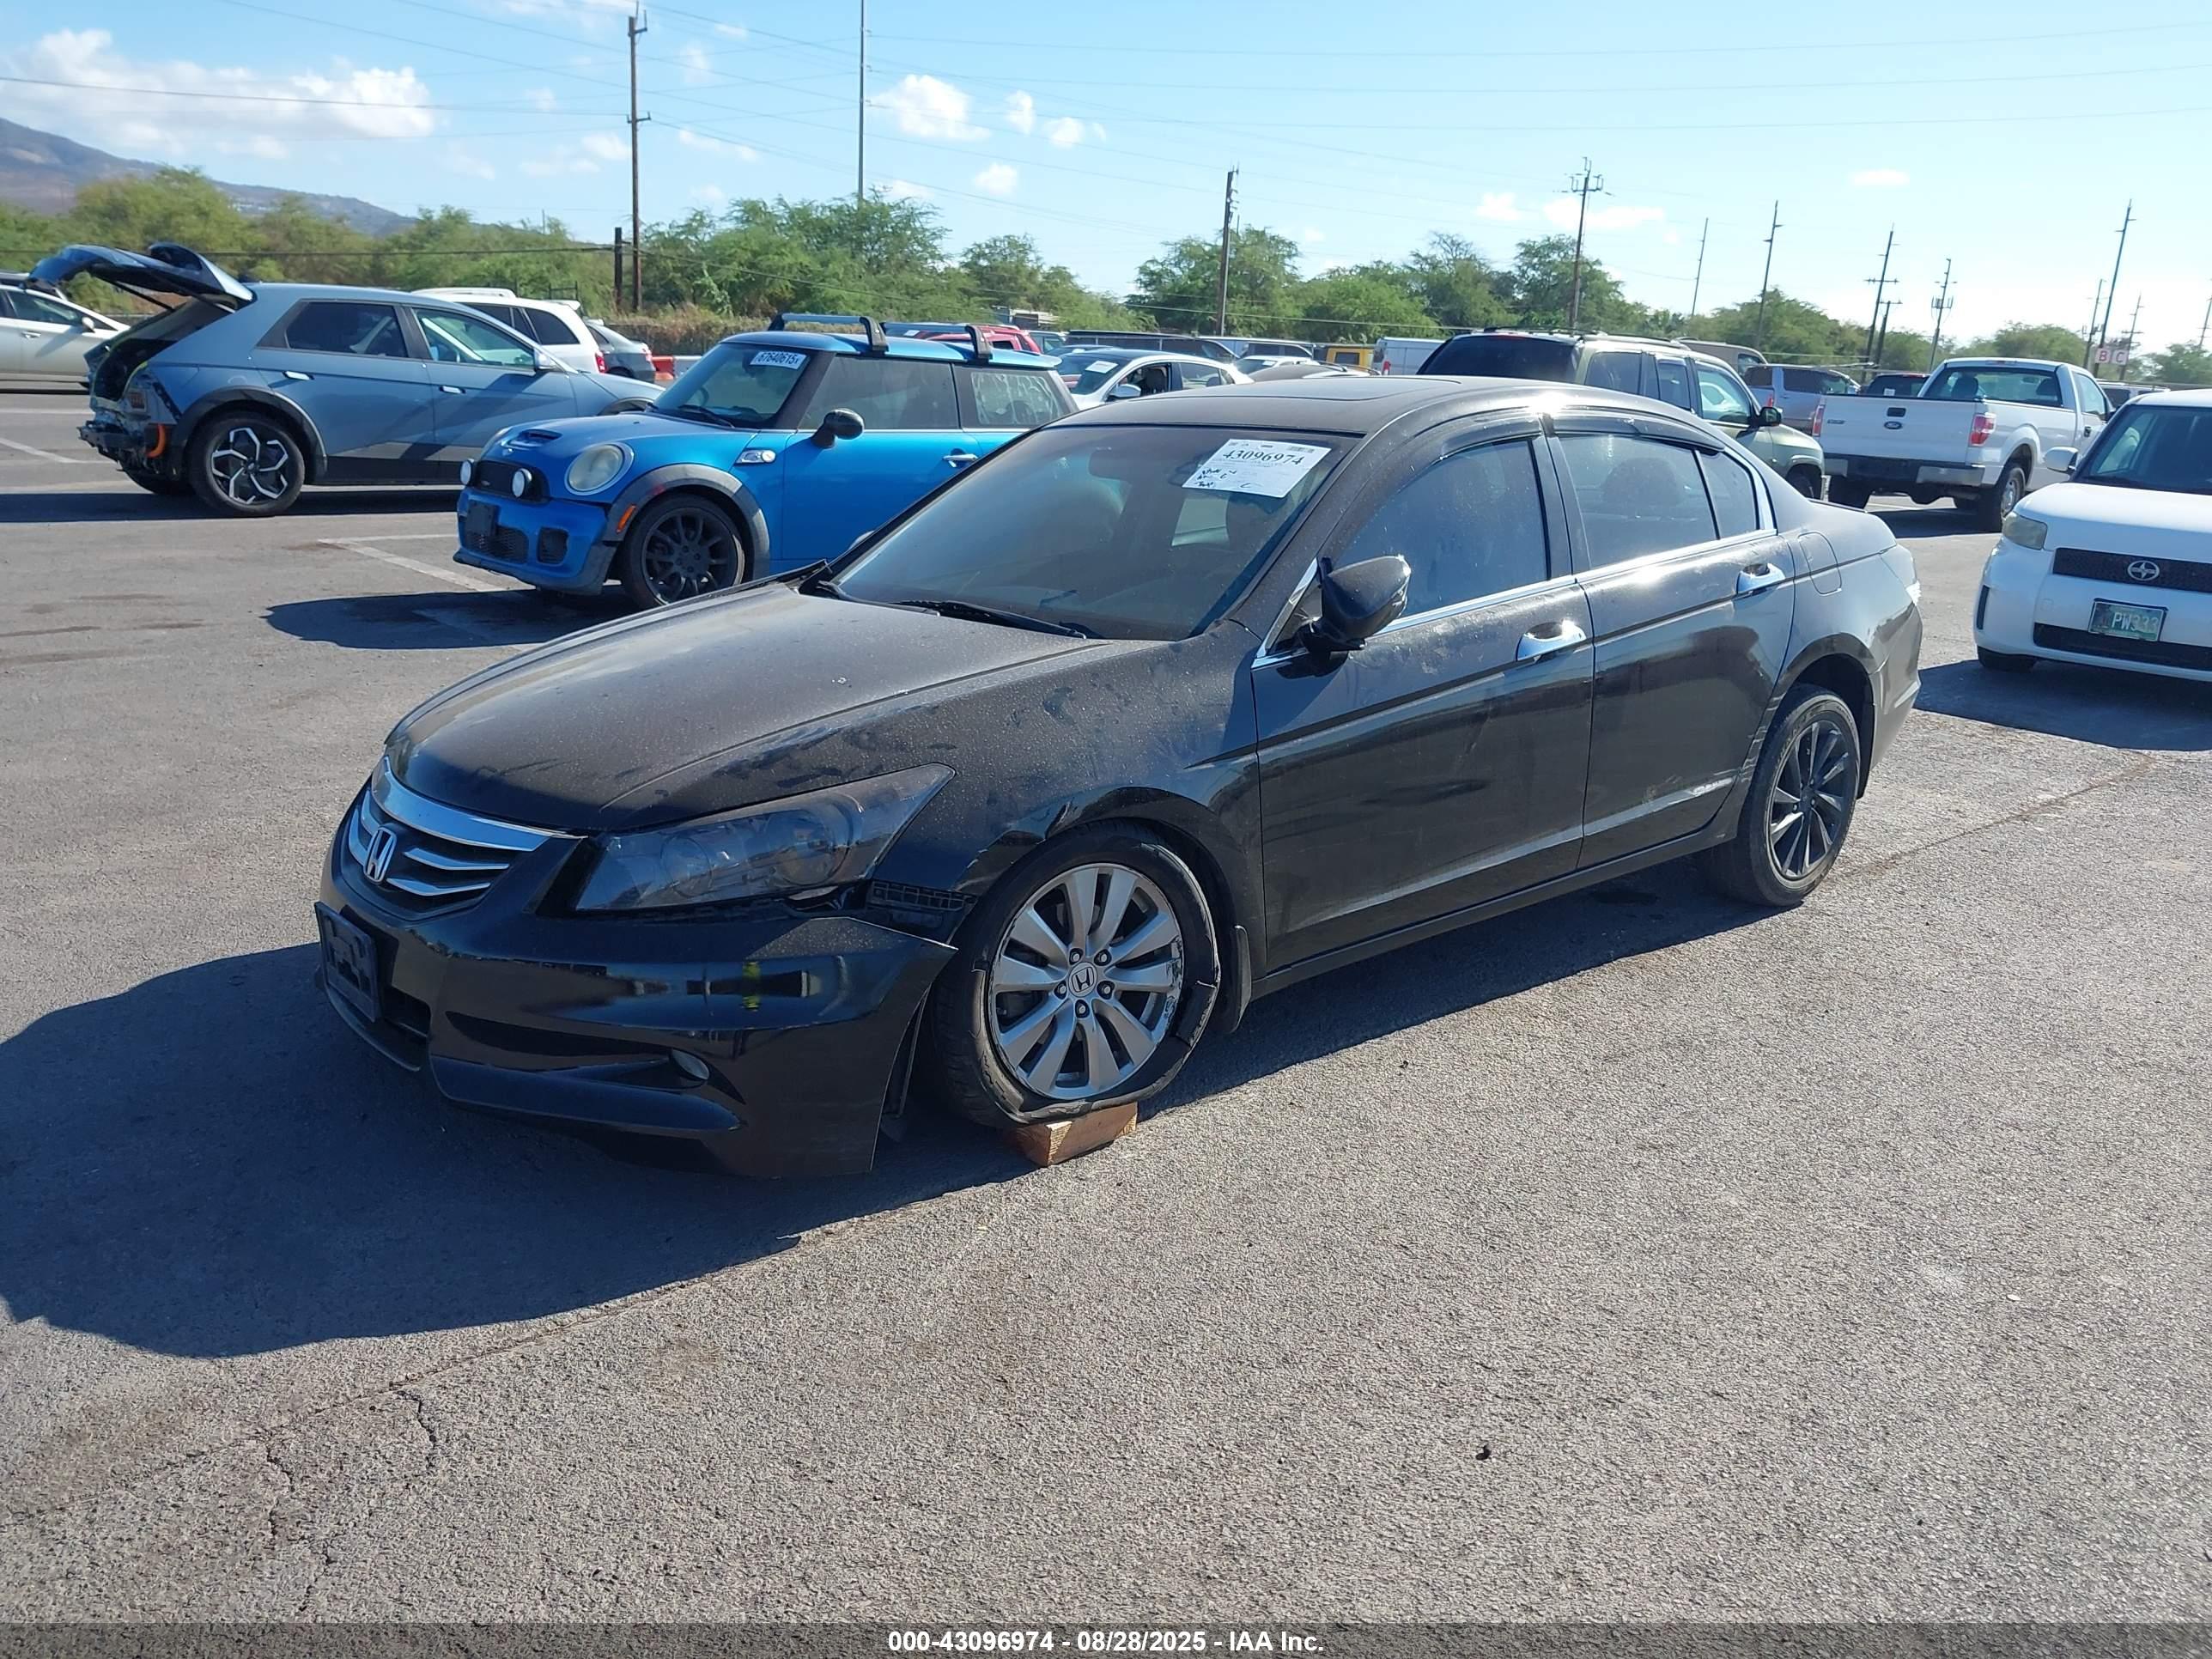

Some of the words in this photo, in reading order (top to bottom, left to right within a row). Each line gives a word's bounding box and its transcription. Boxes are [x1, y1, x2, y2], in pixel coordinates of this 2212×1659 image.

[2099, 349, 2107, 362] B
[2115, 351, 2124, 363] C
[1223, 449, 1304, 465] 43096974
